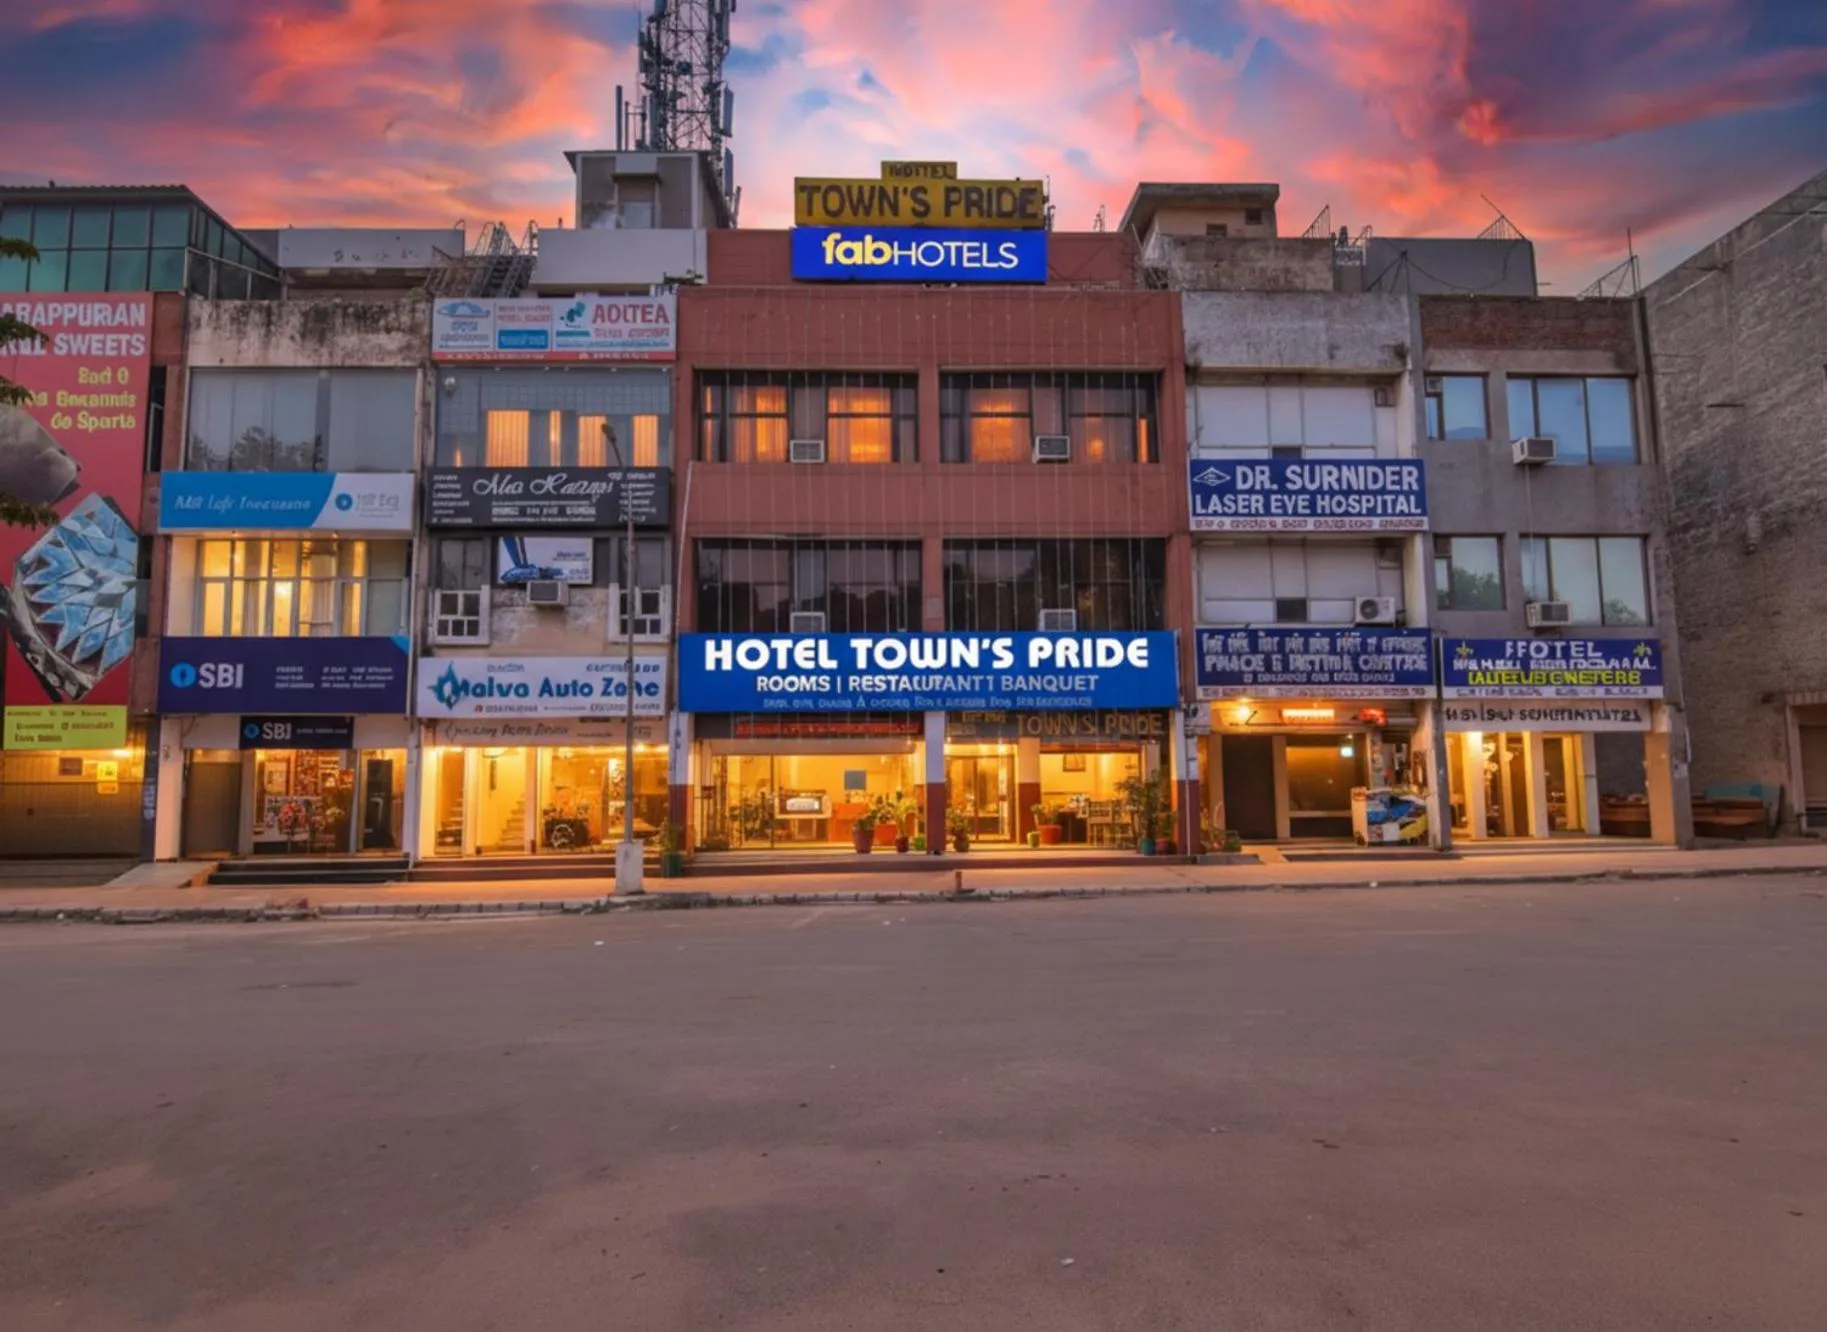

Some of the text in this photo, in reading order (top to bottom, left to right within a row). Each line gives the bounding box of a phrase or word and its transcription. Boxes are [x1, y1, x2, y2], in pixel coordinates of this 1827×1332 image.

[799, 184, 1038, 218] TOWN'S PRIDE
[822, 232, 1019, 269] fabHOTELS
[54, 333, 146, 356] SWEETS
[1236, 465, 1278, 491] DR.
[1195, 494, 1421, 515] LASER EYE HOSPITAL
[704, 637, 1149, 671] HOTEL TOWN'S PRIDE
[198, 662, 244, 689] SBI
[538, 676, 594, 698] Auto
[756, 675, 831, 692] ROOMS
[1001, 674, 1099, 692] BANQUET
[261, 722, 292, 740] SBI
